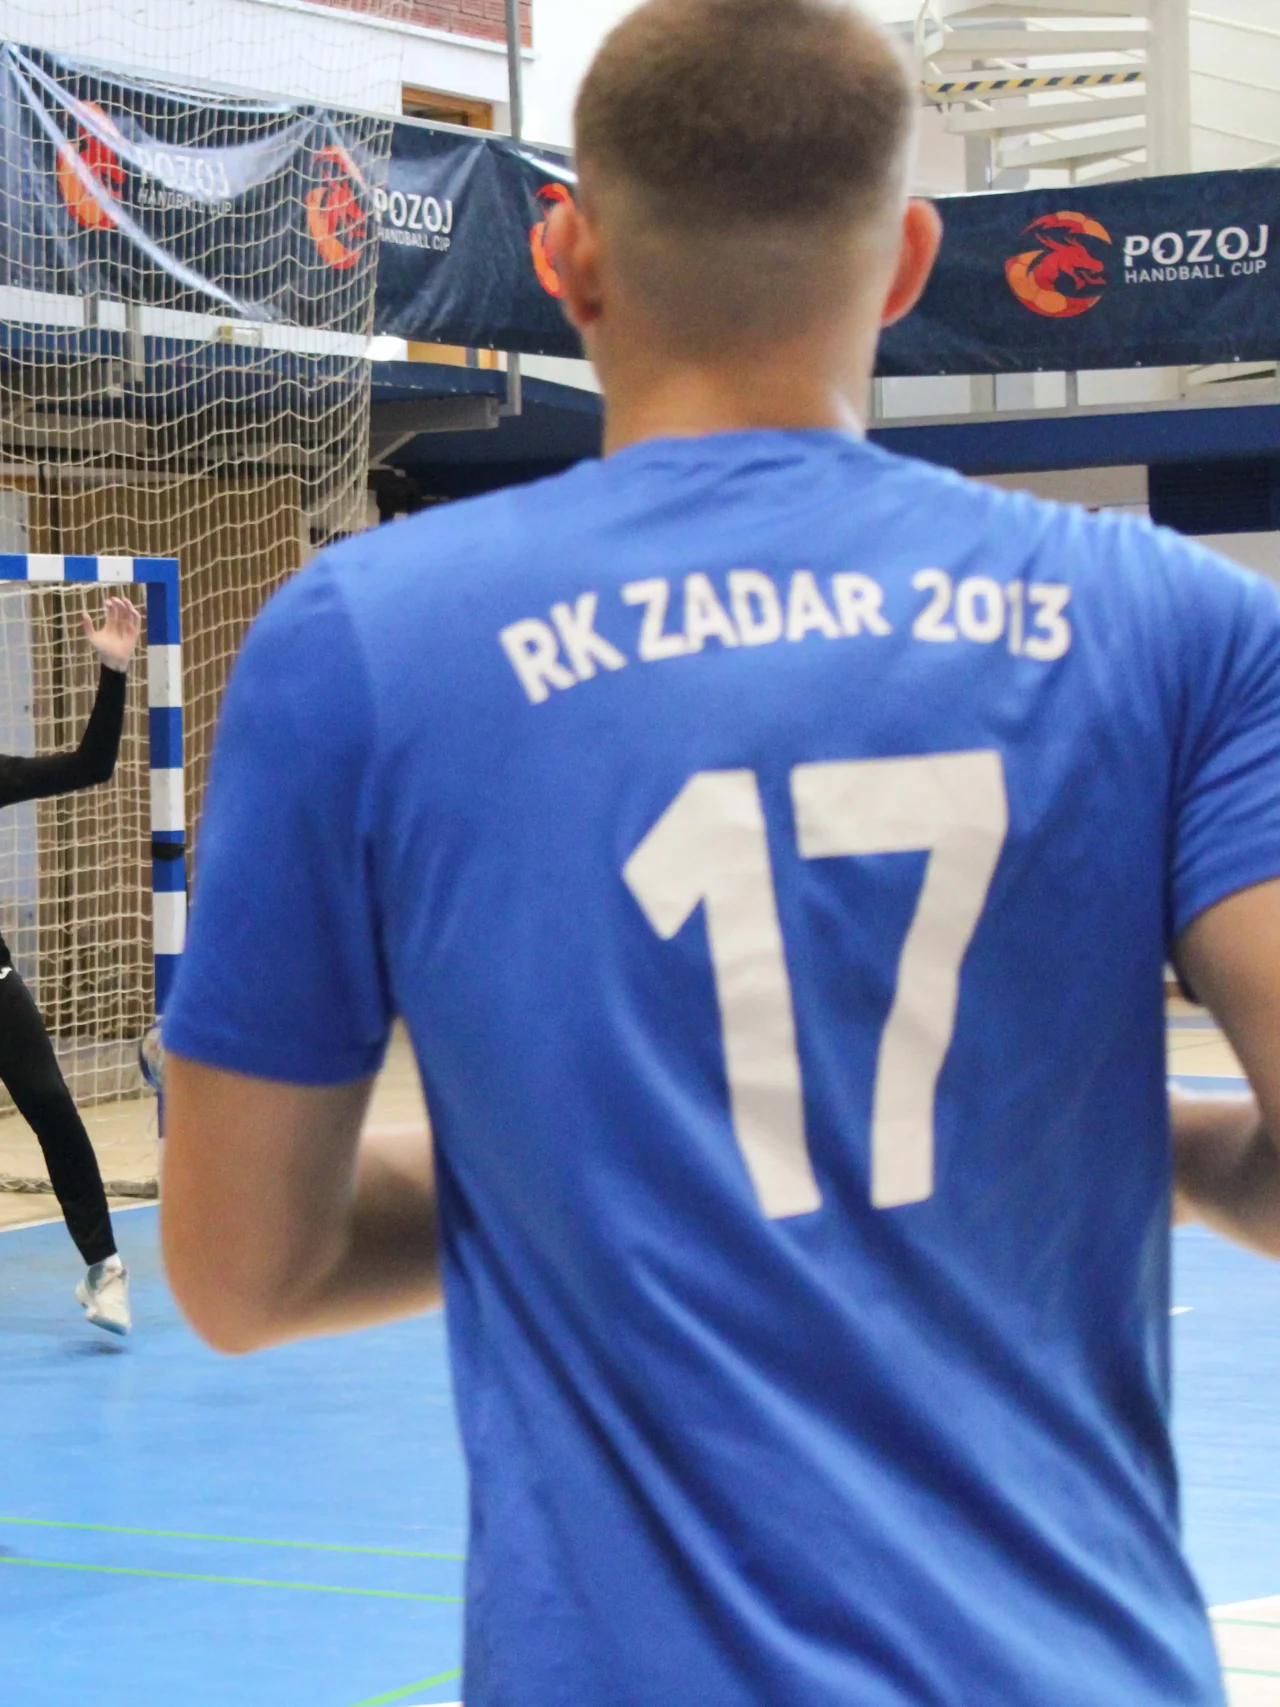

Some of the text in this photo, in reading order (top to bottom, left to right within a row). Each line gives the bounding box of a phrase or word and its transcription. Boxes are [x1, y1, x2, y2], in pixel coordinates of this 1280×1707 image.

[134, 146, 230, 198] POZOJ
[373, 187, 453, 234] POZOJ
[1123, 224, 1269, 267] POZOJ
[1124, 259, 1267, 284] HANDBALL CUP
[498, 567, 1072, 706] RK ZADAR 2013
[622, 748, 1010, 1221] 17
